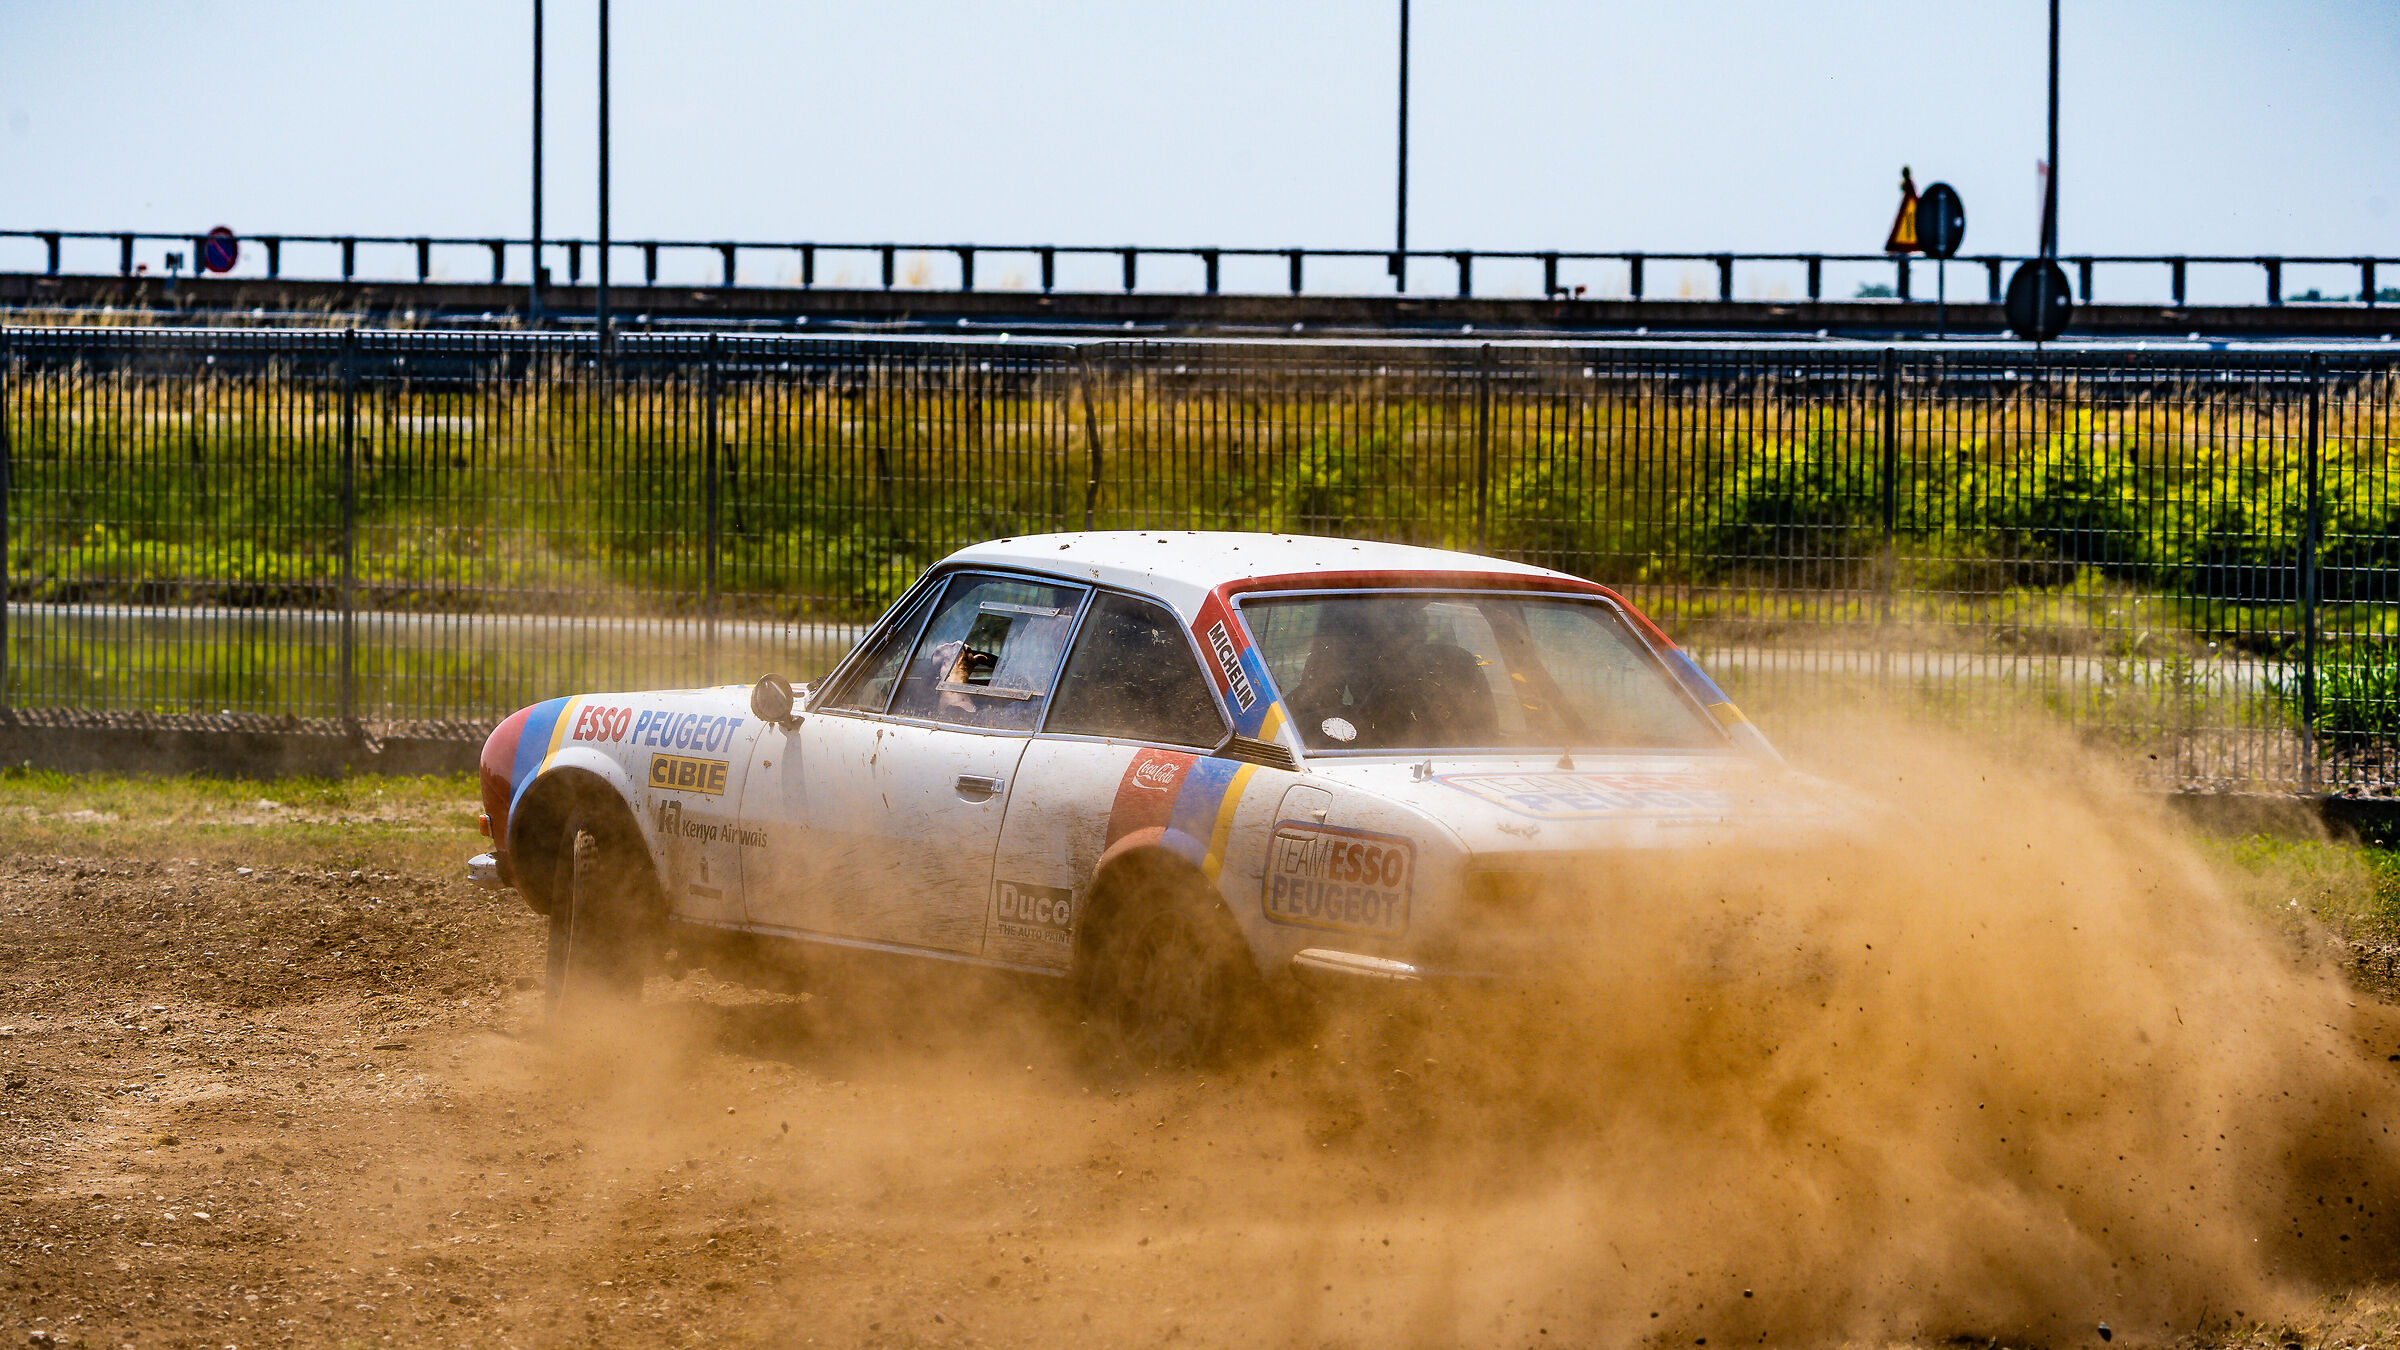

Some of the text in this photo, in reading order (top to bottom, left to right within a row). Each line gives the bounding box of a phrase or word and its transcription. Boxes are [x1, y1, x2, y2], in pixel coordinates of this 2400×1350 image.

[1209, 622, 1255, 711] MICHELIN
[572, 705, 745, 753] ESSO PEUGEOT
[682, 820, 717, 845] Kenya
[1276, 833, 1404, 887] TEAM ESSO
[1000, 883, 1070, 925] Duco
[1272, 877, 1404, 928] PEUGEOT
[998, 923, 1016, 936] THE
[1018, 927, 1042, 940] AUTO
